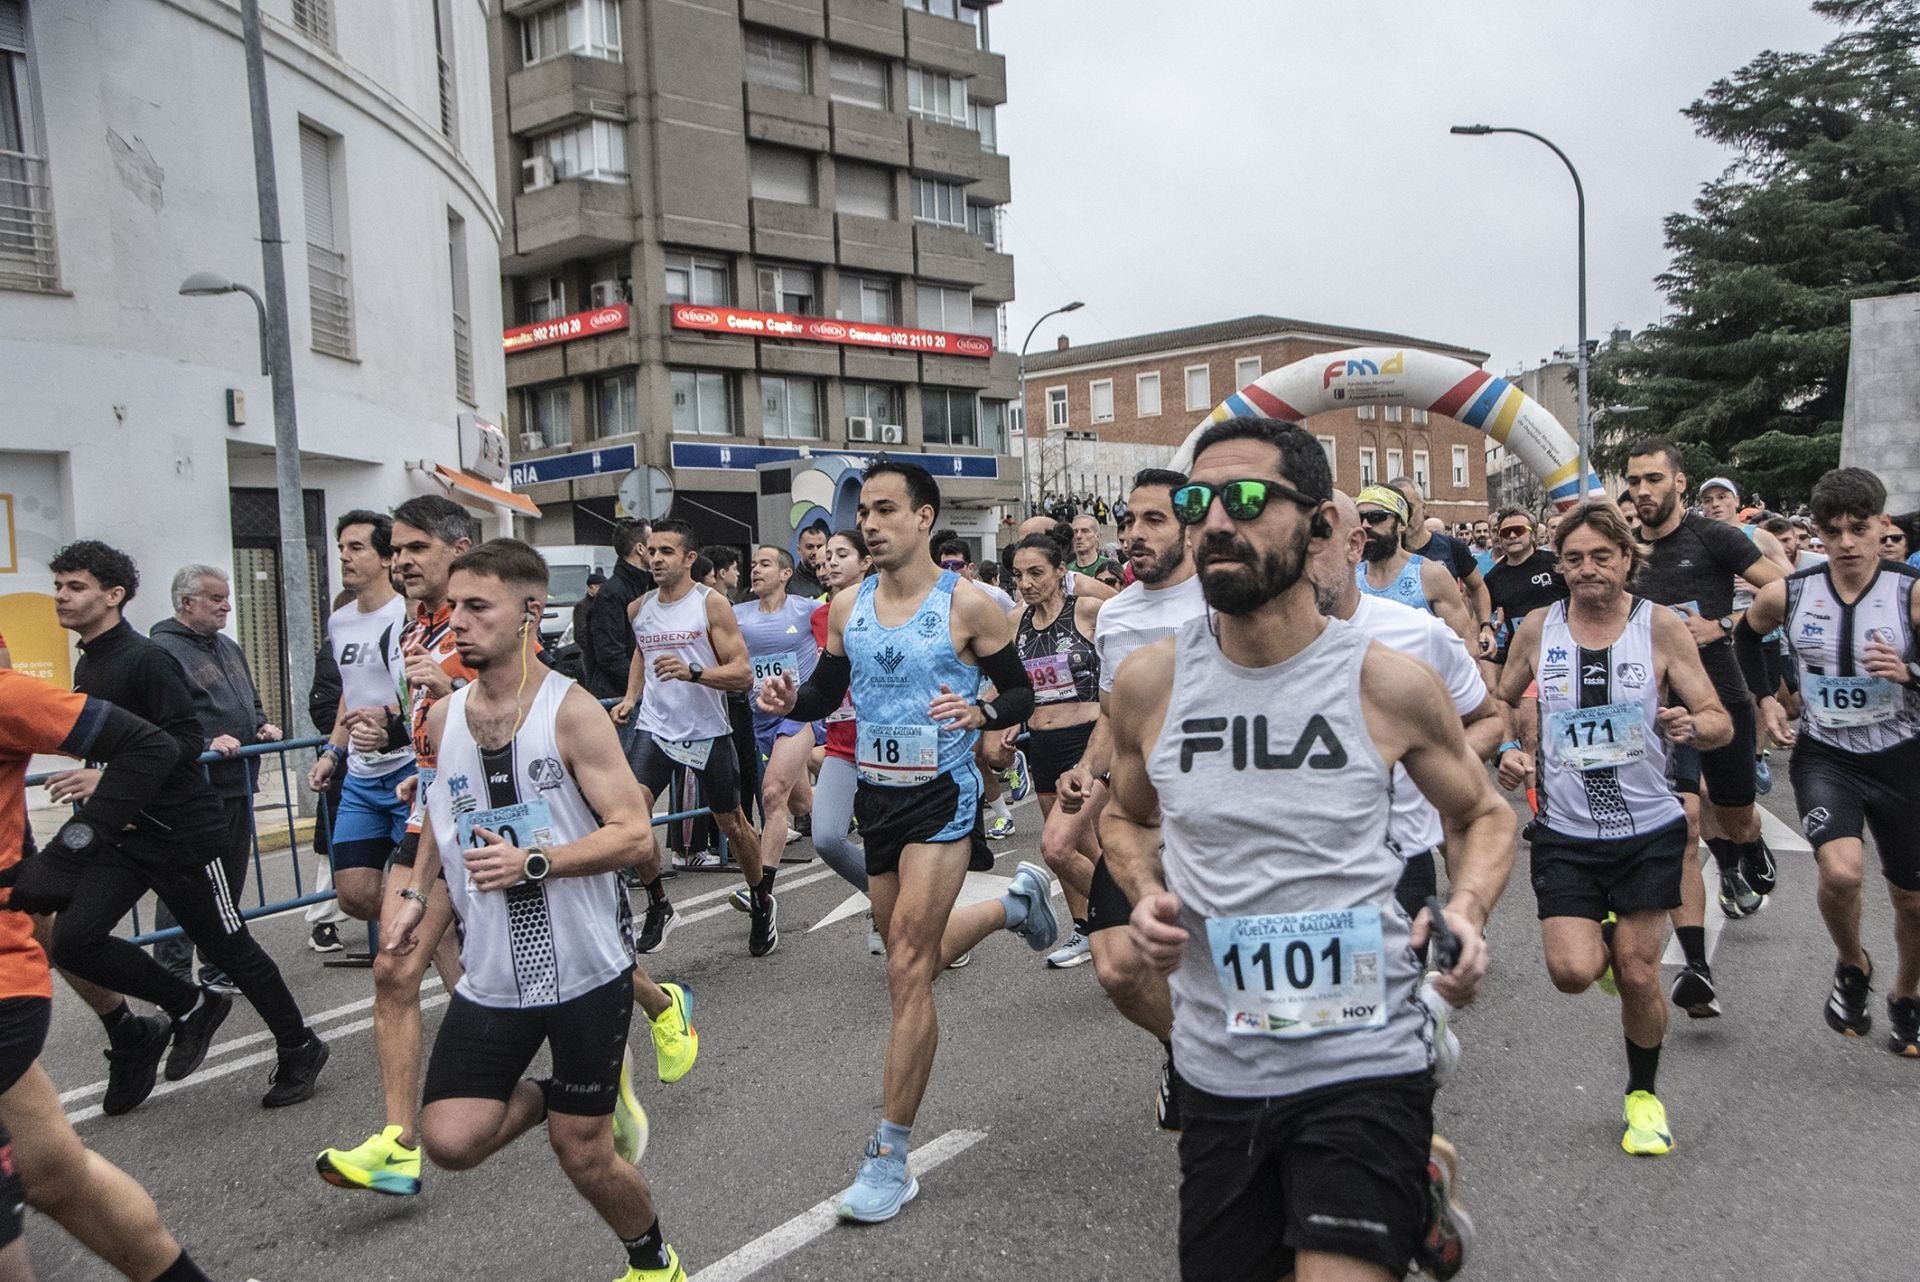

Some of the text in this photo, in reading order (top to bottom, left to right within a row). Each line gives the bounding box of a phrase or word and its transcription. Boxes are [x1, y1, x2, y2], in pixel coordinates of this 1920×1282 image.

[727, 315, 804, 335] Centro Capilar
[891, 332, 908, 346] 902
[935, 336, 946, 349] 20
[511, 464, 539, 486] RÍA
[755, 662, 783, 679] 816
[1818, 687, 1867, 709] 169
[1180, 713, 1348, 773] FILA
[1565, 719, 1614, 748] 171
[873, 738, 900, 764] 18
[1237, 925, 1277, 937] VUELTA
[1281, 925, 1295, 934] AL
[1300, 920, 1355, 932] BALUARTE
[1258, 915, 1298, 926] CROSS
[1302, 911, 1354, 922] POPULAR
[1223, 937, 1342, 991] 1101
[1343, 1005, 1377, 1018] HOY
